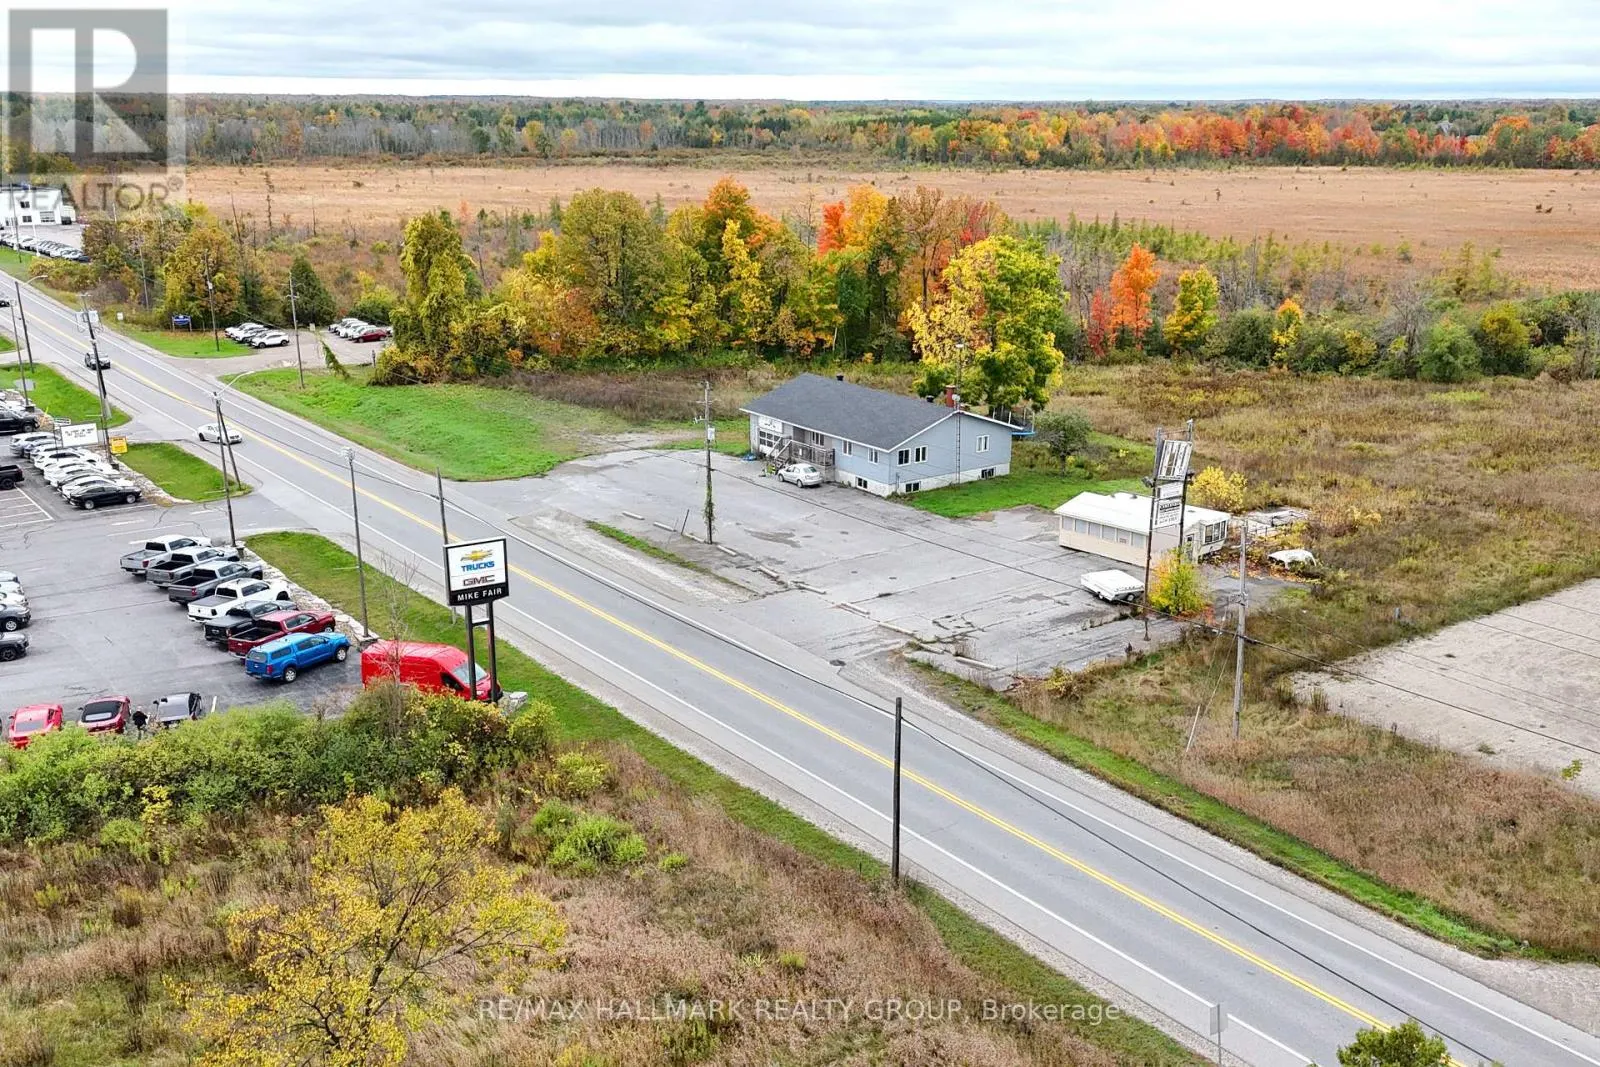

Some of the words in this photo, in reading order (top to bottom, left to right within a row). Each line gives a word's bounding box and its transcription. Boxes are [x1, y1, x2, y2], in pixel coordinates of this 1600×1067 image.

[462, 561, 495, 572] TRUCKS
[463, 575, 495, 586] GMC
[457, 591, 479, 601] MIKE
[482, 588, 502, 598] FAIR
